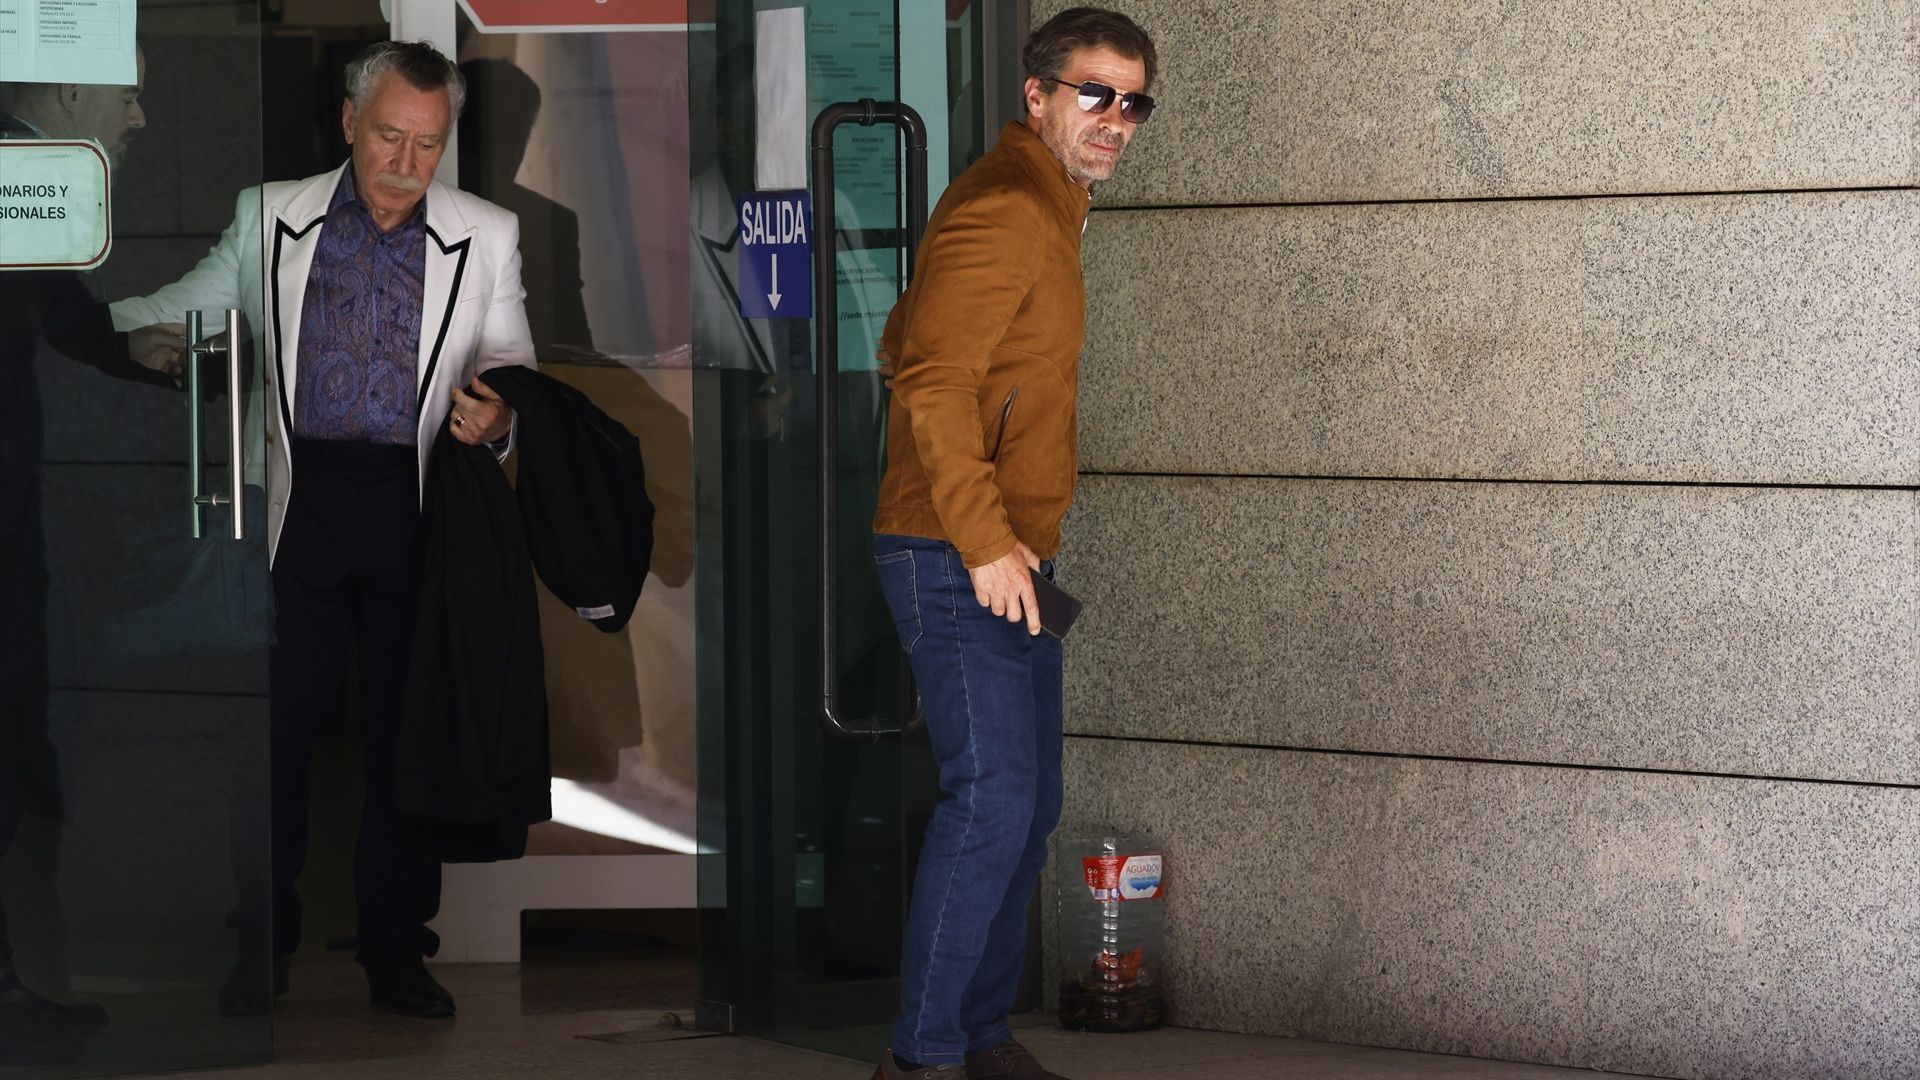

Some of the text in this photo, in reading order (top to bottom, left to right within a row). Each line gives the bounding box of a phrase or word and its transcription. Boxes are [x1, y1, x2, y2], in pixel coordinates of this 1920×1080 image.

[0, 185, 68, 198] NARIOS Y
[742, 200, 807, 245] SALIDA
